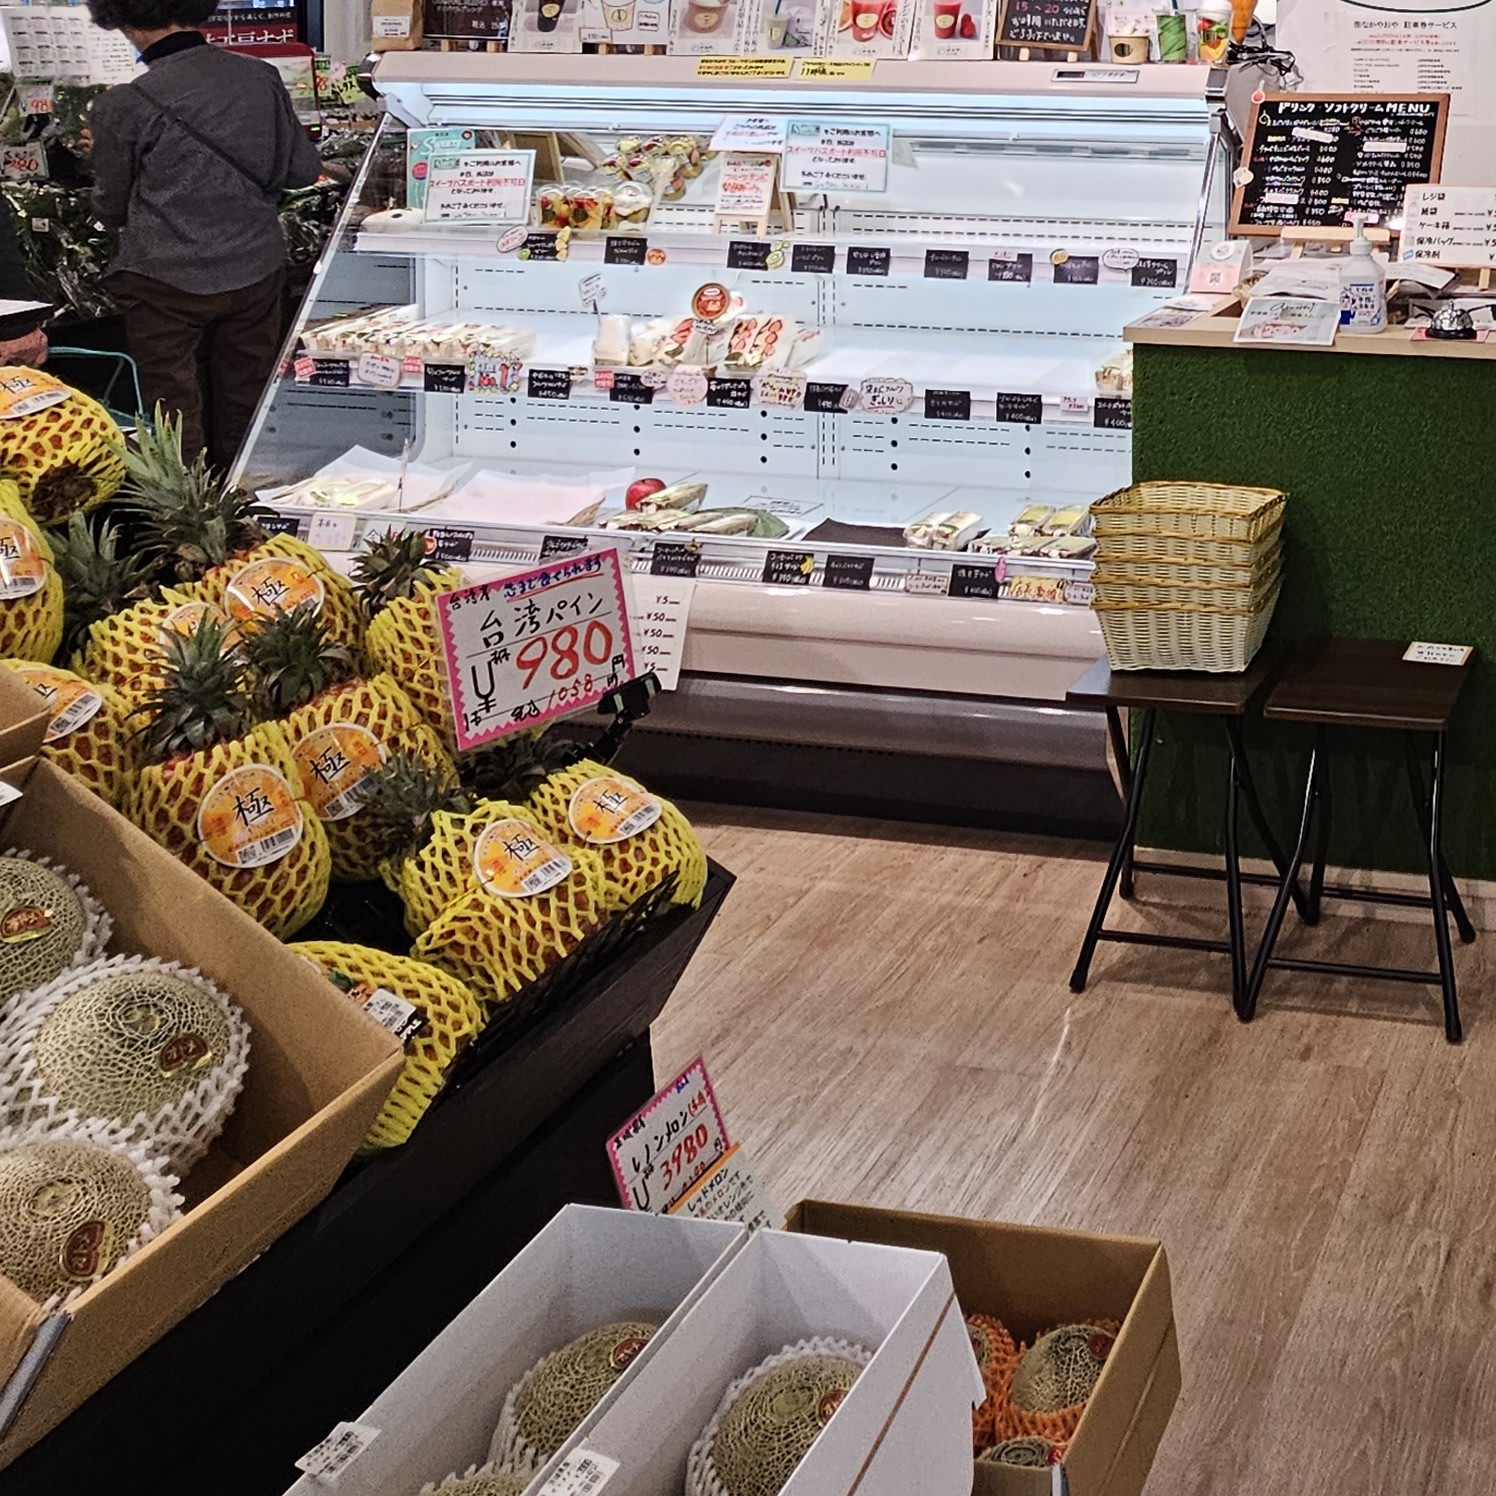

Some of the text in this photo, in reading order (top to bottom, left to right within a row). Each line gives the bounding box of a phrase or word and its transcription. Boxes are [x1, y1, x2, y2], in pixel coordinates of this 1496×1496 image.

[251, 578, 293, 607] 極
[480, 592, 604, 649] 台湾パイン
[515, 619, 613, 691] 980
[549, 673, 594, 702] 1058
[309, 745, 351, 784] 極
[231, 787, 275, 827] 極
[593, 790, 630, 815] 極
[503, 833, 541, 862] 極
[660, 1122, 708, 1191] 3980
